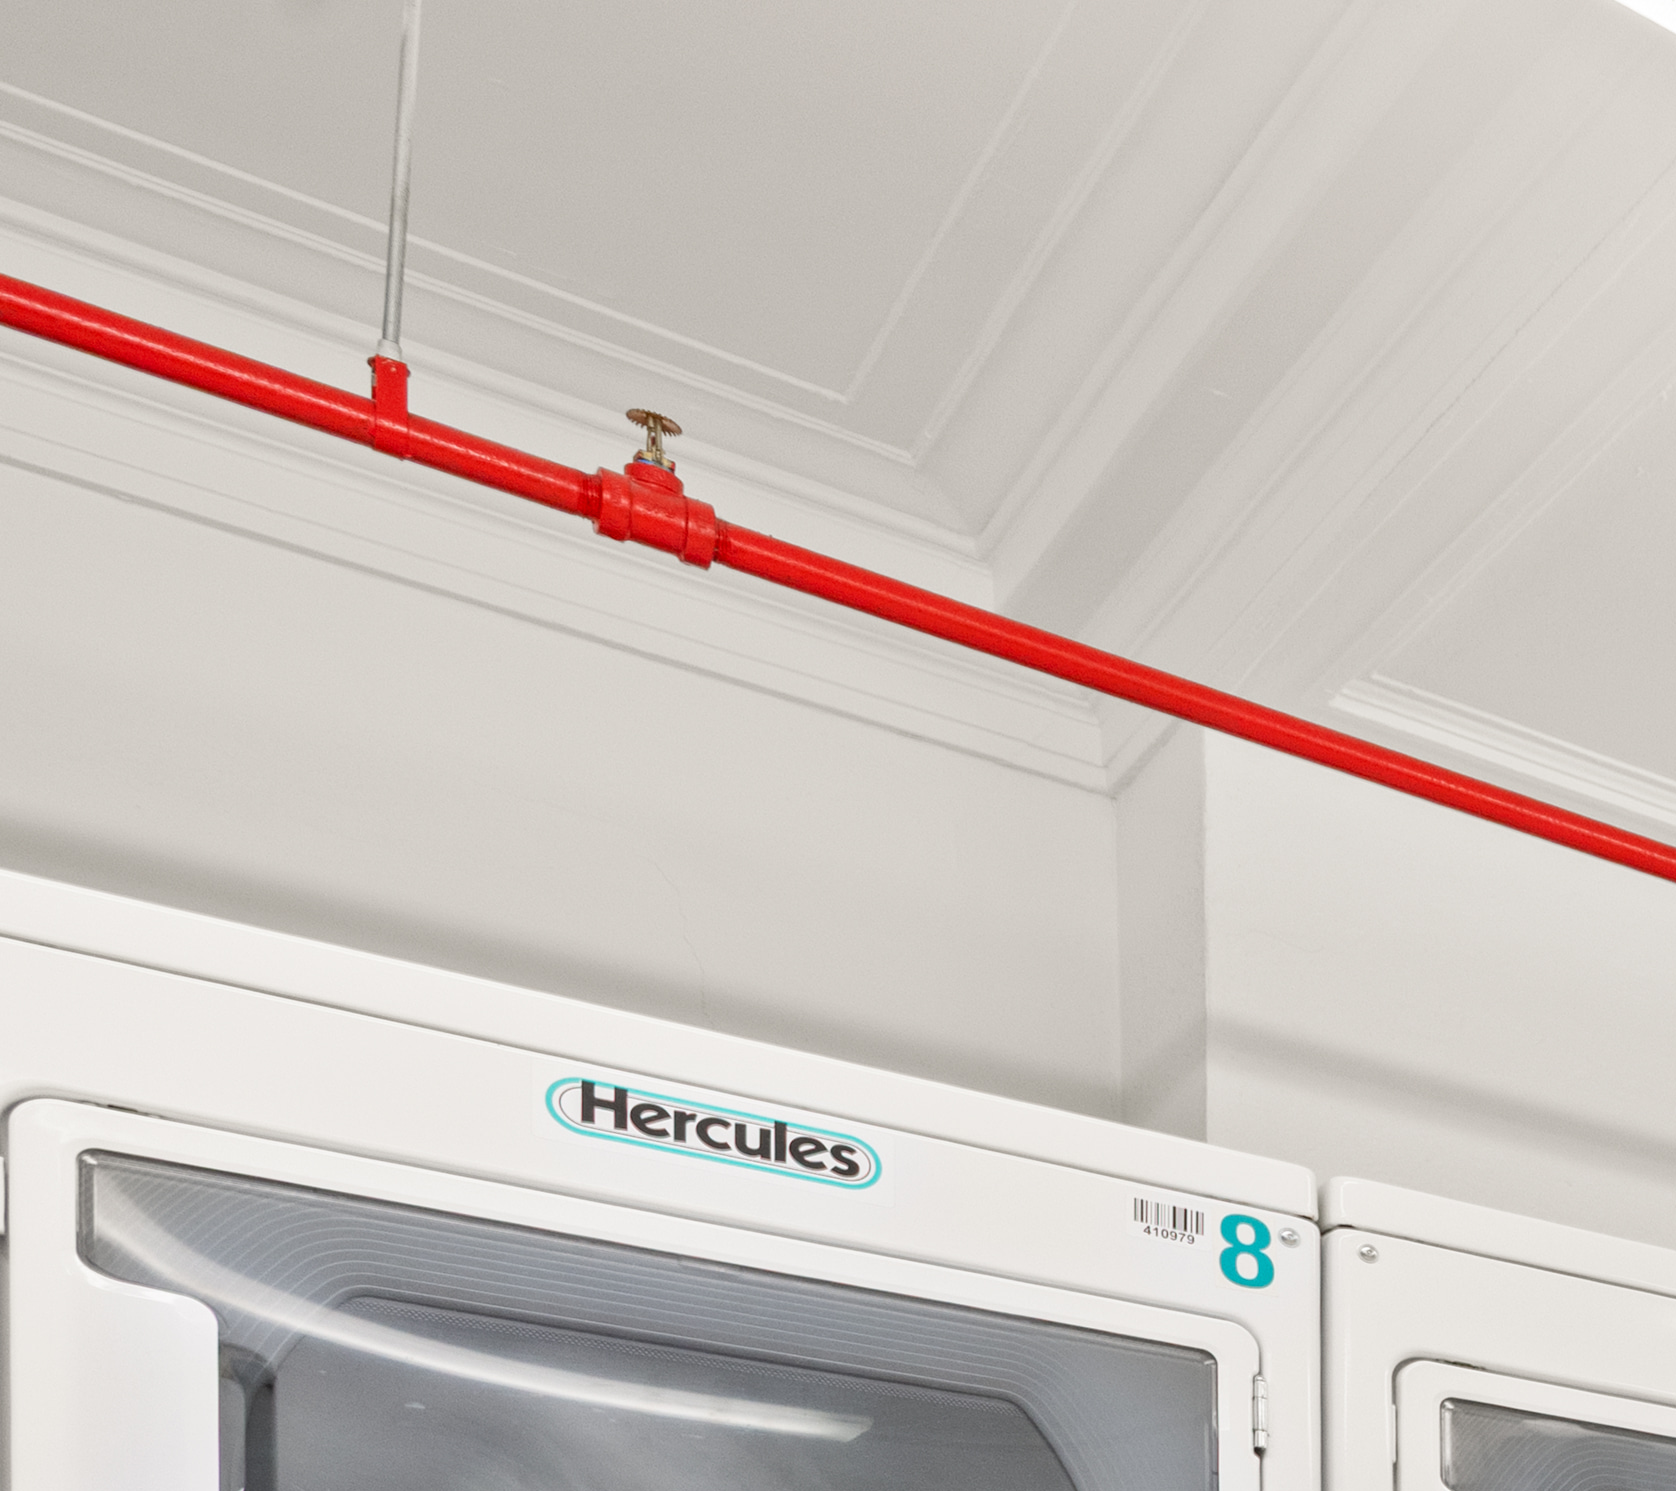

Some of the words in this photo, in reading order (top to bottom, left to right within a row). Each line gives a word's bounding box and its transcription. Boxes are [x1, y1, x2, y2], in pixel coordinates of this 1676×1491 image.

[580, 1082, 864, 1184] Hercules
[1143, 1224, 1197, 1246] 410979
[1218, 1213, 1276, 1290] 8
